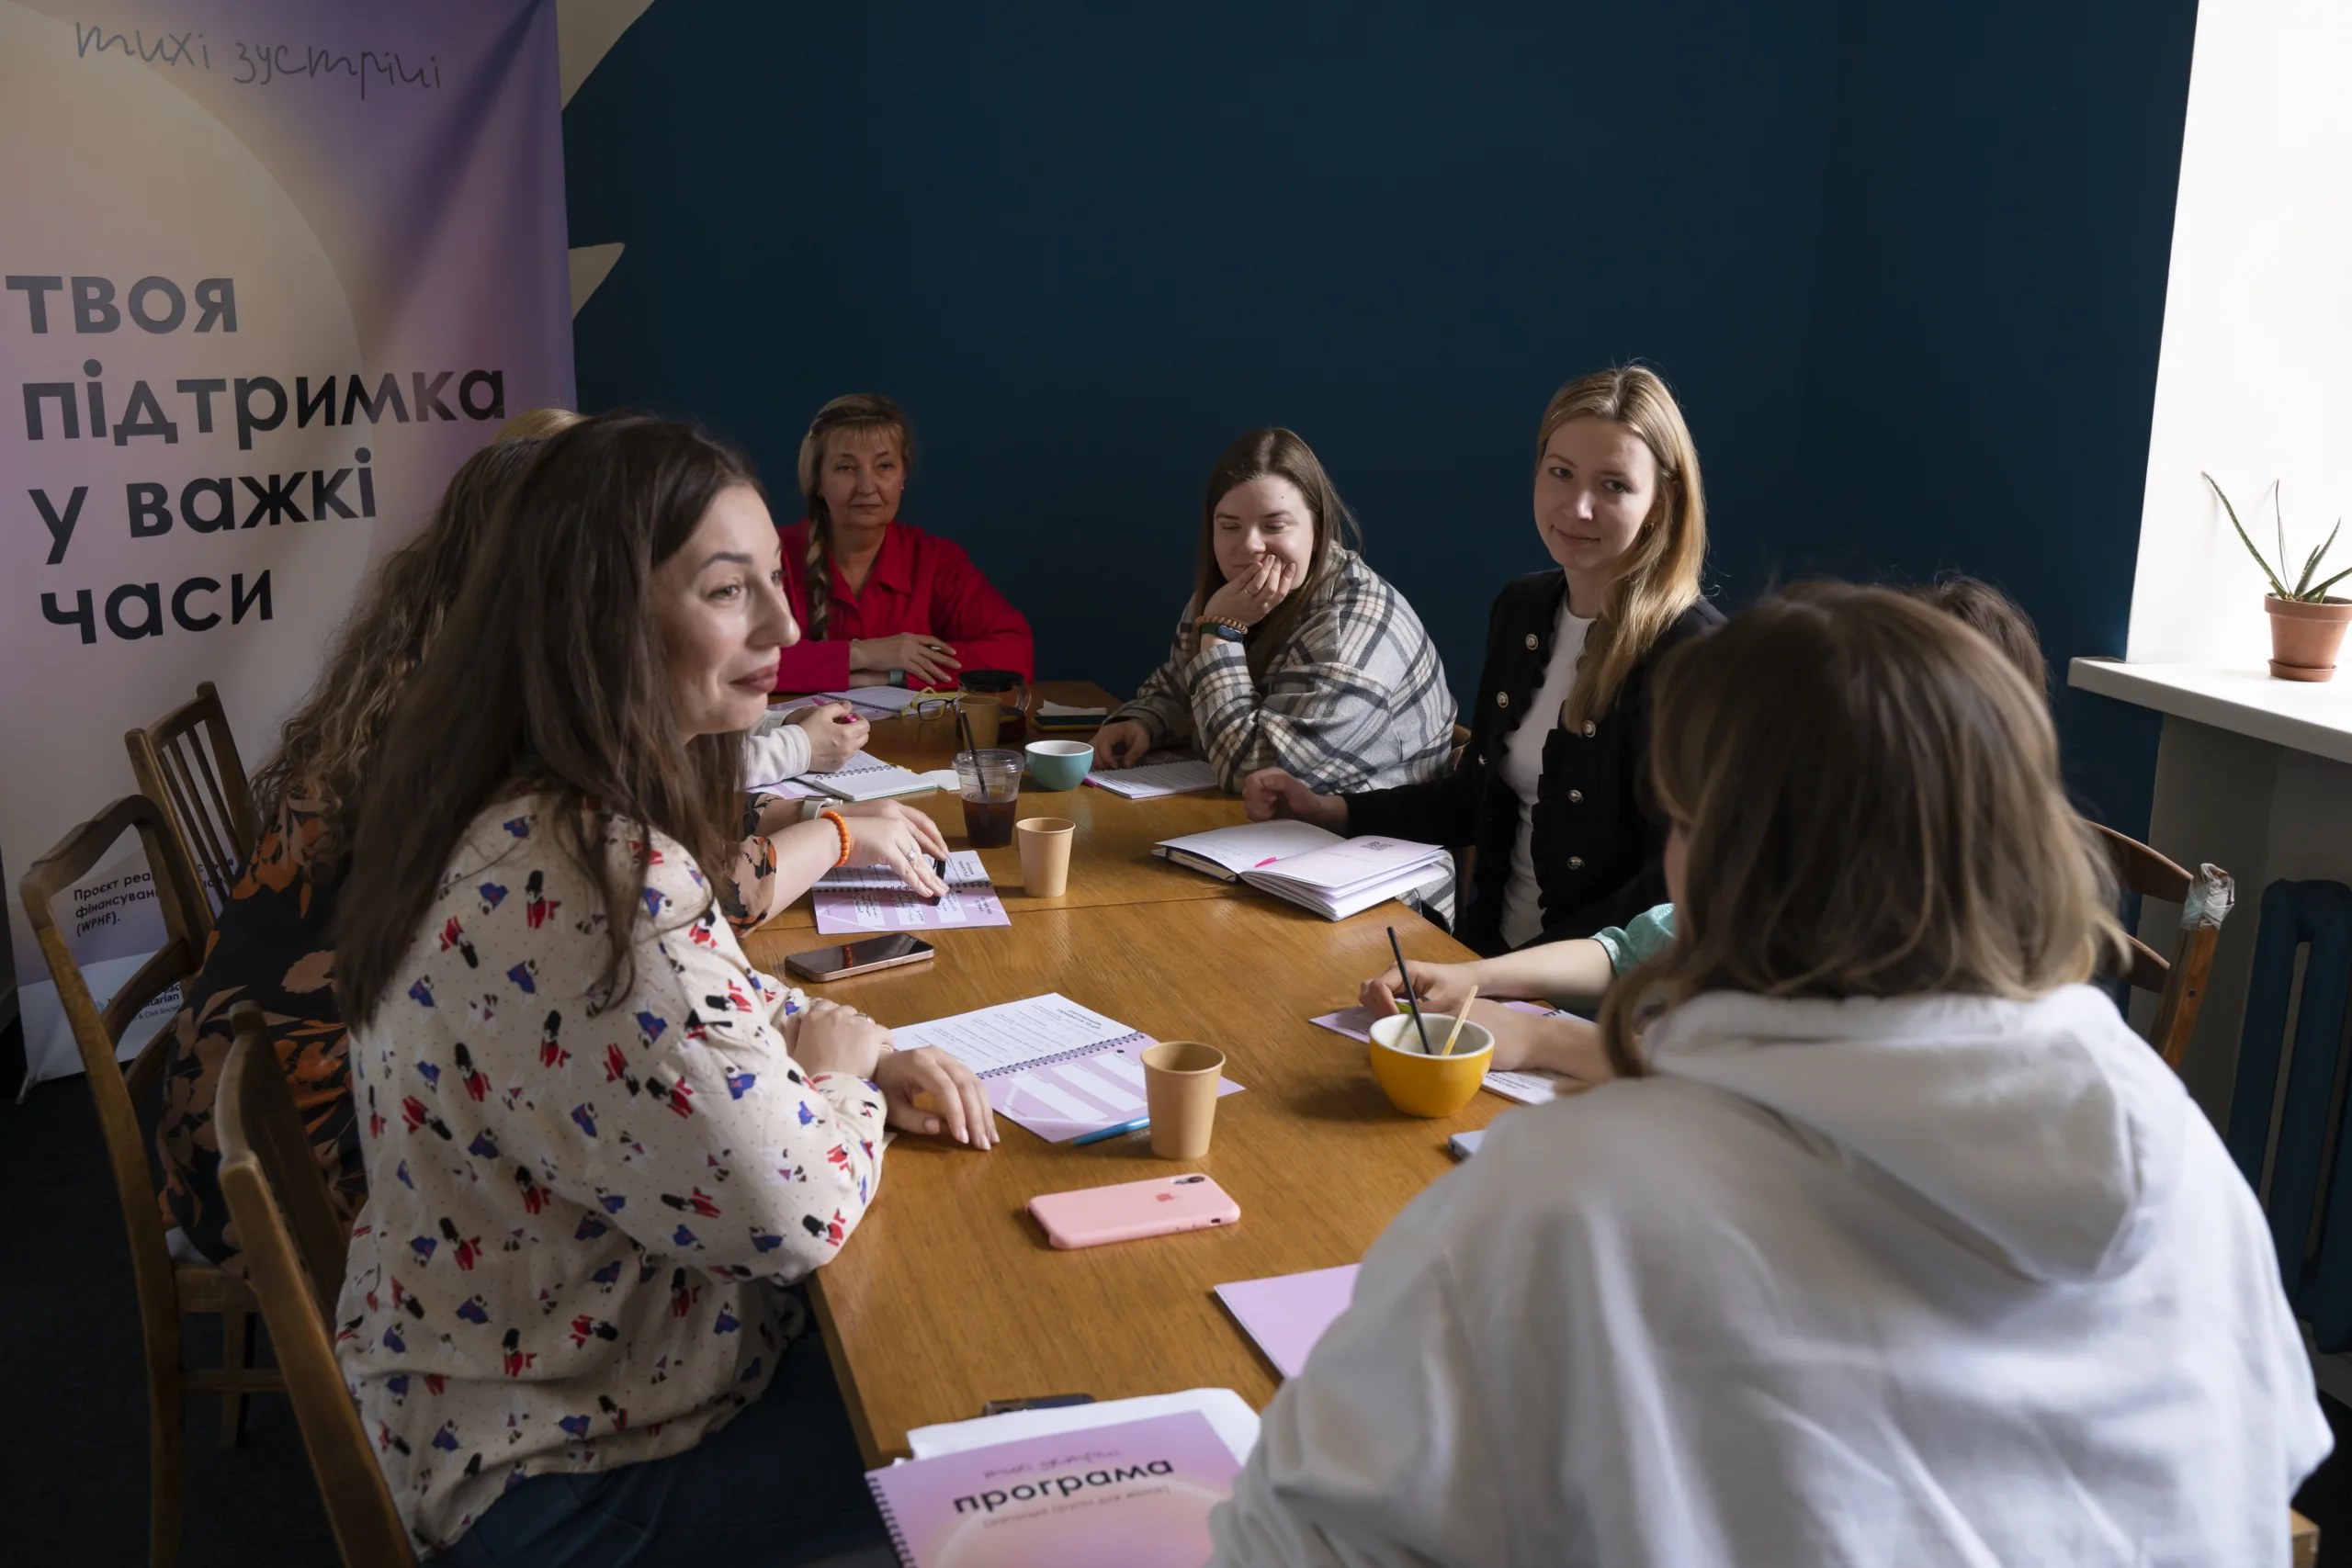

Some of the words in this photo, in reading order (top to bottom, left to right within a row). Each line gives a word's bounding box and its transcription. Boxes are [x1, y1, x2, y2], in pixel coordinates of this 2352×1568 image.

[76, 22, 209, 69] тихі
[233, 42, 441, 100] зустрічі
[22, 359, 505, 450] підтримка
[28, 486, 89, 565] у
[127, 447, 376, 538] важкі
[40, 570, 273, 645] часи
[74, 879, 119, 902] Проєкт
[74, 888, 157, 919] фінансуван
[953, 1458, 1175, 1515] програма
